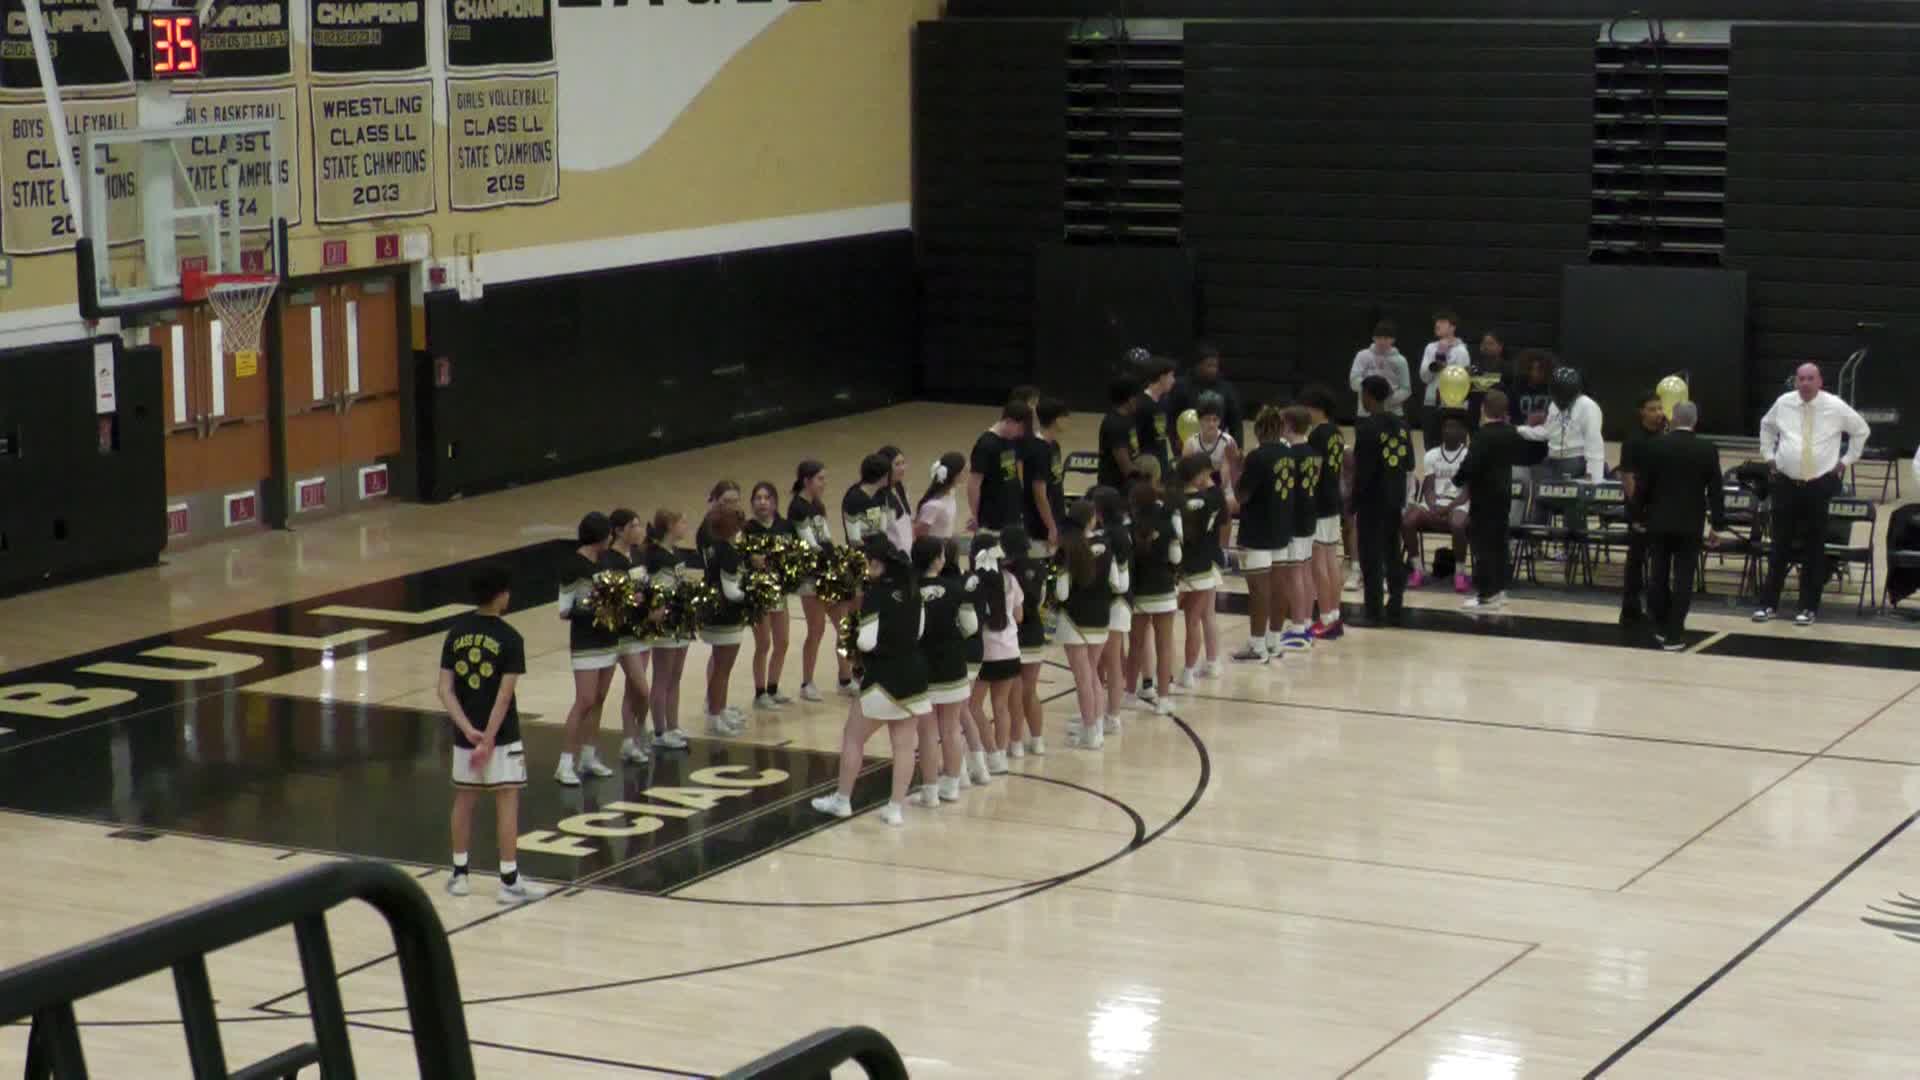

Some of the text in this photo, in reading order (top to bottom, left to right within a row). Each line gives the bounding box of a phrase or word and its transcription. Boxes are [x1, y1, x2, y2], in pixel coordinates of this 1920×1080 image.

[152, 17, 197, 73] 35
[323, 95, 423, 118] WRESTLING
[456, 87, 550, 110] GIRLS VOLLEYBALL
[13, 111, 128, 139] BOYS LLEYBALL
[330, 123, 417, 146] CLASS LL
[463, 115, 543, 137] CLASS LL
[323, 148, 426, 180] STATE CHAMPIONS
[458, 139, 552, 169] STATE CHAMPIONS
[12, 180, 56, 207] STATE
[353, 183, 400, 205] 2013
[487, 174, 525, 194] 2019
[516, 765, 790, 857] FCIAC
